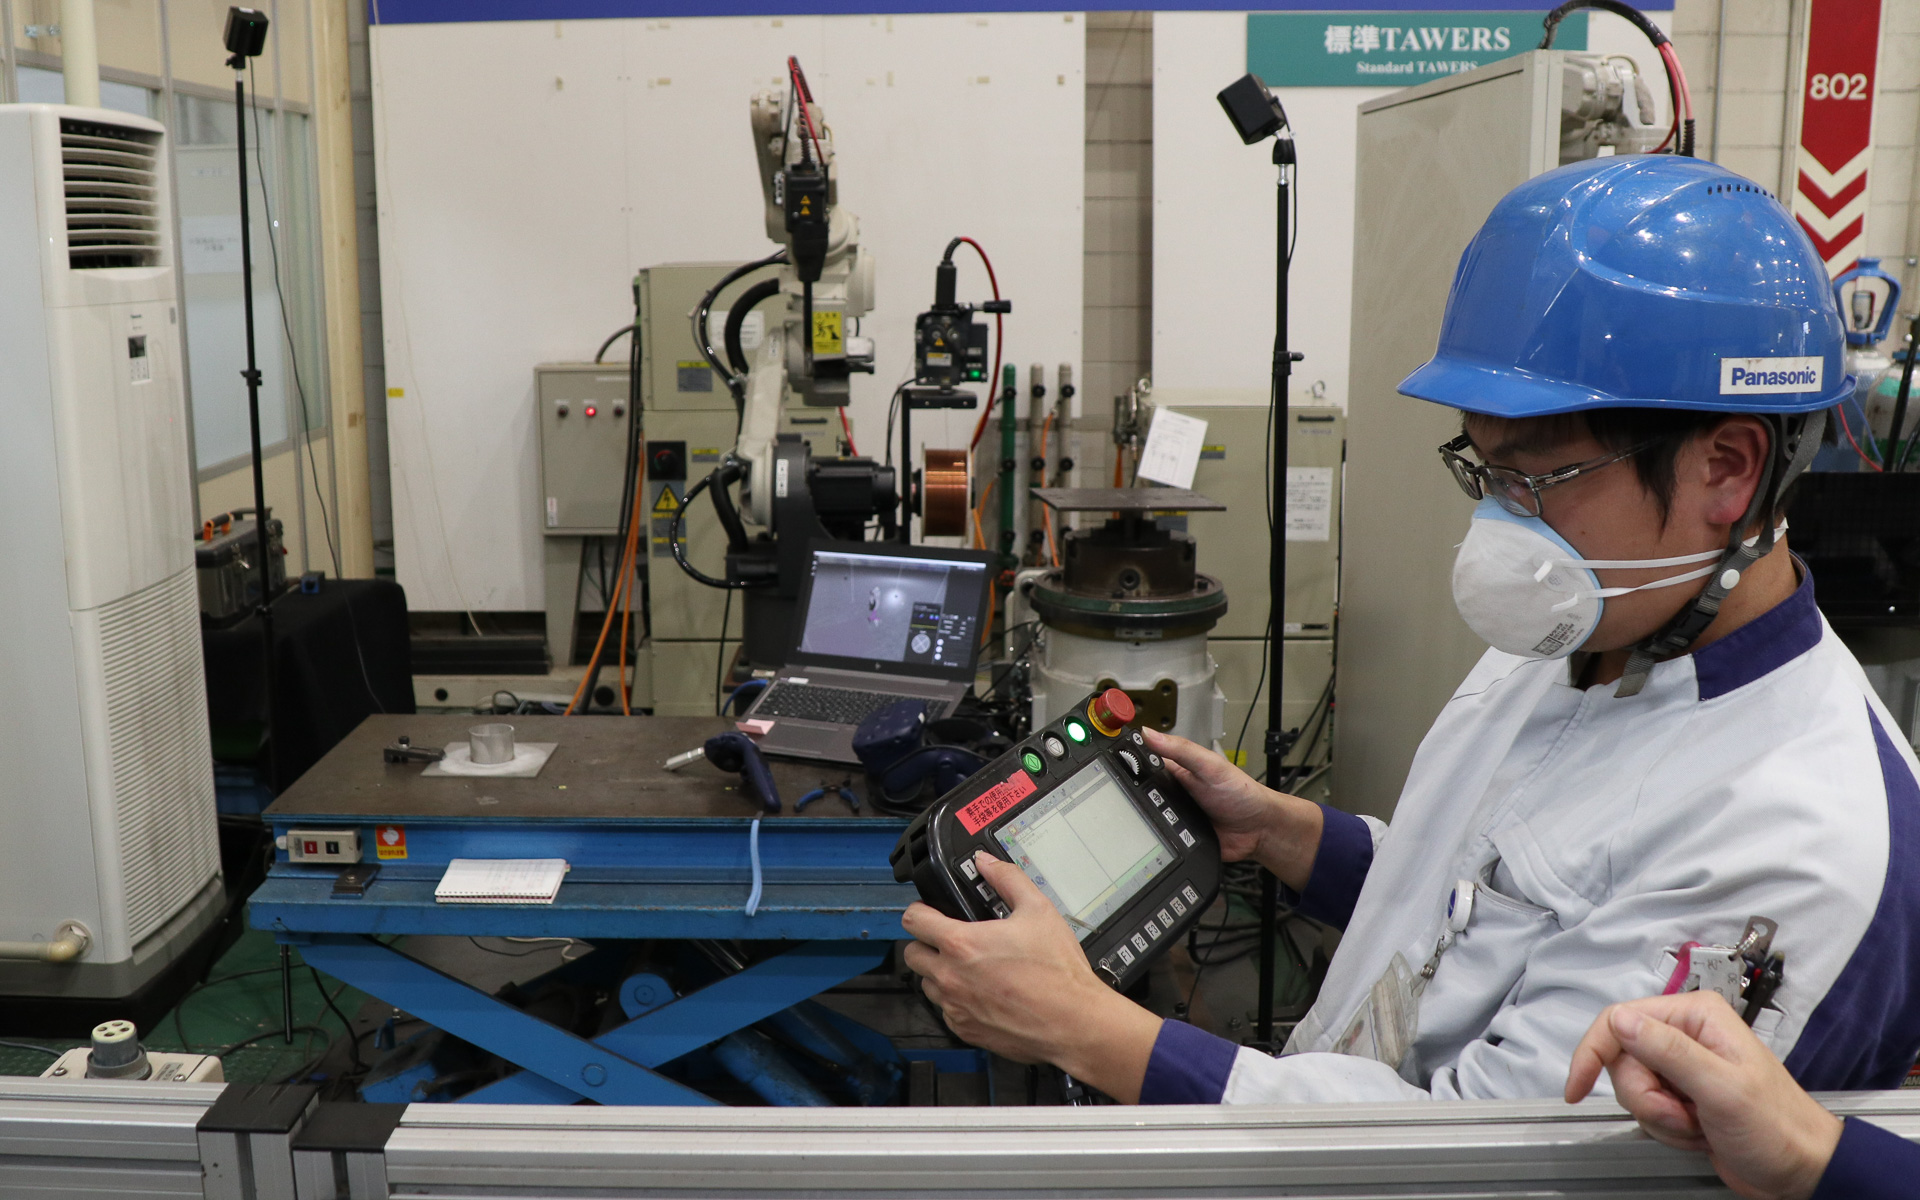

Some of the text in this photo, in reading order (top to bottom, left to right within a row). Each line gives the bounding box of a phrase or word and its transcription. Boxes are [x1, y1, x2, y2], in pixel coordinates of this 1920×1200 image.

[1324, 24, 1511, 54] 標準TAWERS
[1356, 61, 1414, 74] Standard
[1810, 73, 1867, 100] 802
[1731, 366, 1816, 386] Panasonic
[1185, 889, 1196, 901] F6
[1173, 901, 1184, 912] F5
[1160, 912, 1171, 924] F4
[1147, 924, 1159, 936] F3
[1134, 937, 1145, 949] F2
[1120, 950, 1132, 962] F1
